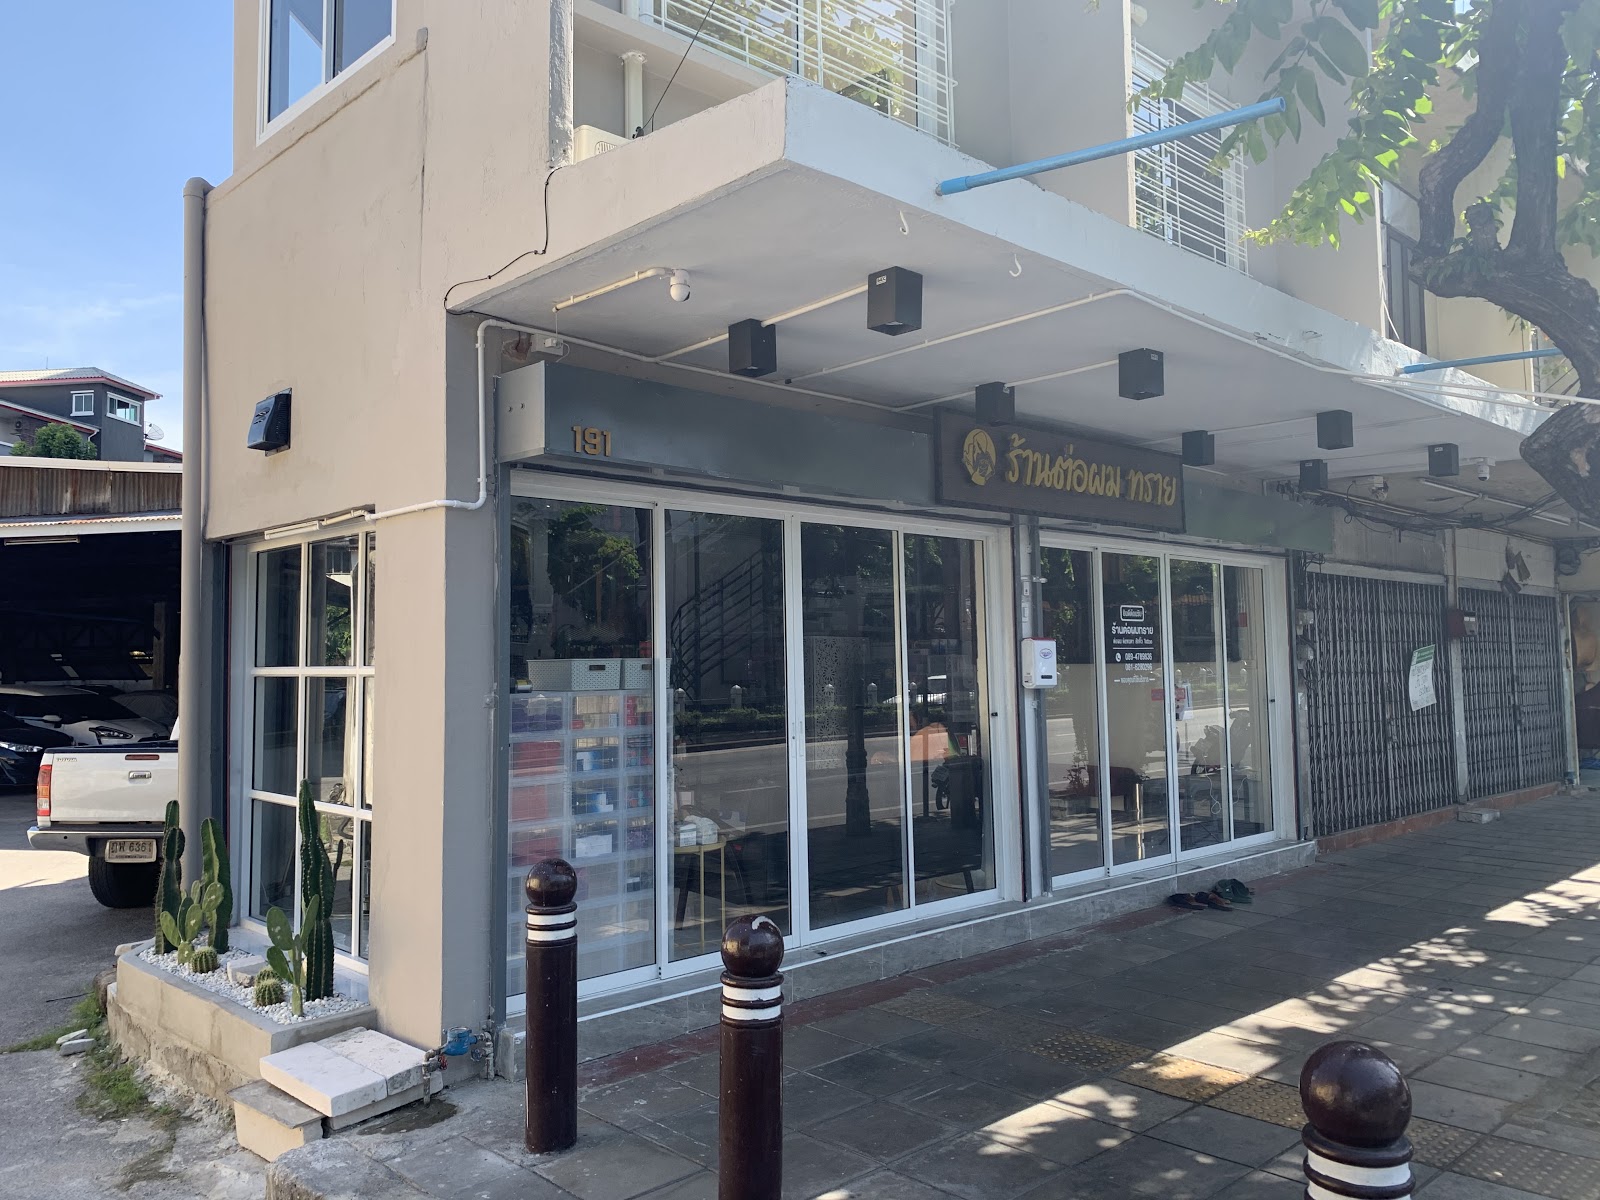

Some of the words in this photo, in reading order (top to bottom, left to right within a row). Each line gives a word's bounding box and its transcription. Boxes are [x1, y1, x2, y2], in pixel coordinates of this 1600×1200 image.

[572, 425, 612, 457] 191
[1006, 433, 1121, 499] ร้านต่อผม
[1128, 469, 1177, 506] ทราย
[129, 842, 152, 853] 6361
